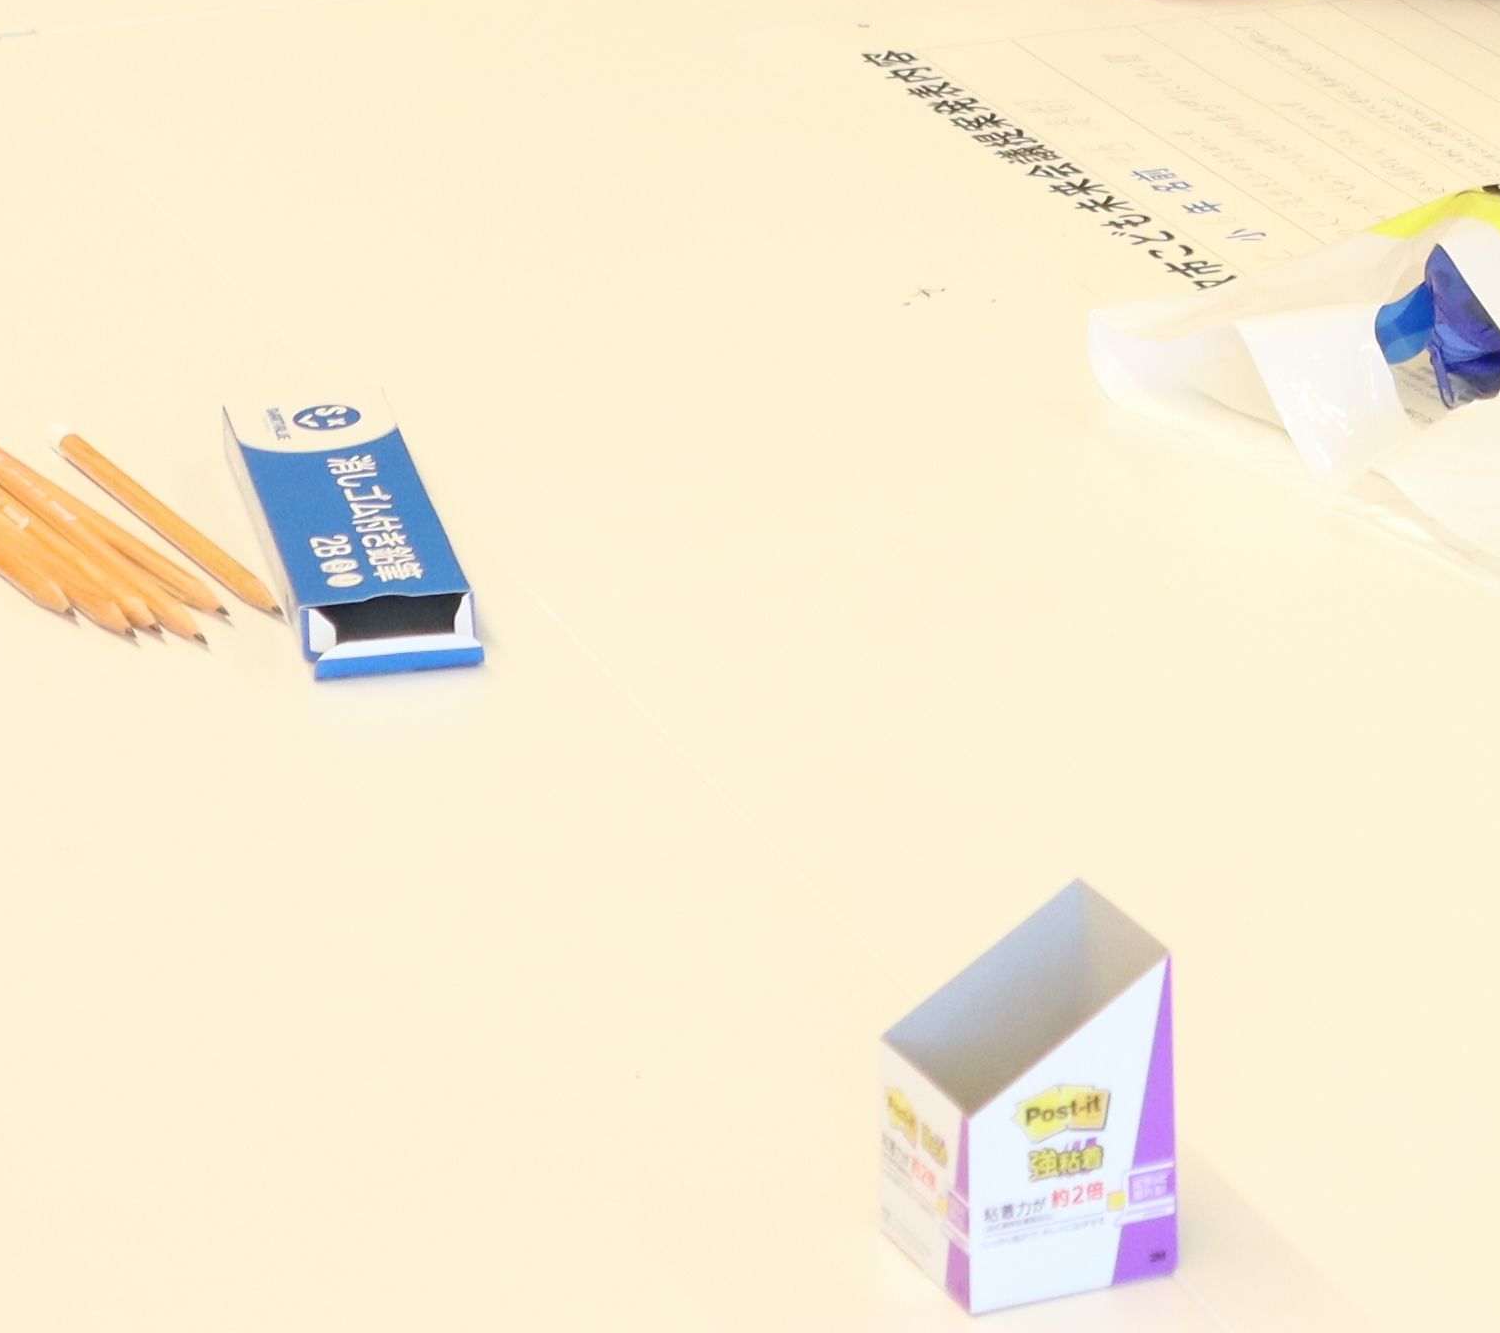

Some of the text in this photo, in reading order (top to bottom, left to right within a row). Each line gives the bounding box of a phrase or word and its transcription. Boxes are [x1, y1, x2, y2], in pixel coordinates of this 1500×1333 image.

[326, 453, 424, 582] 消しゴム付き鉛筆
[309, 533, 354, 558] 2B
[1024, 1095, 1101, 1127] Post-it
[1028, 1144, 1104, 1183] 強粘着
[983, 1181, 1105, 1223] 粘着力が 約2倍
